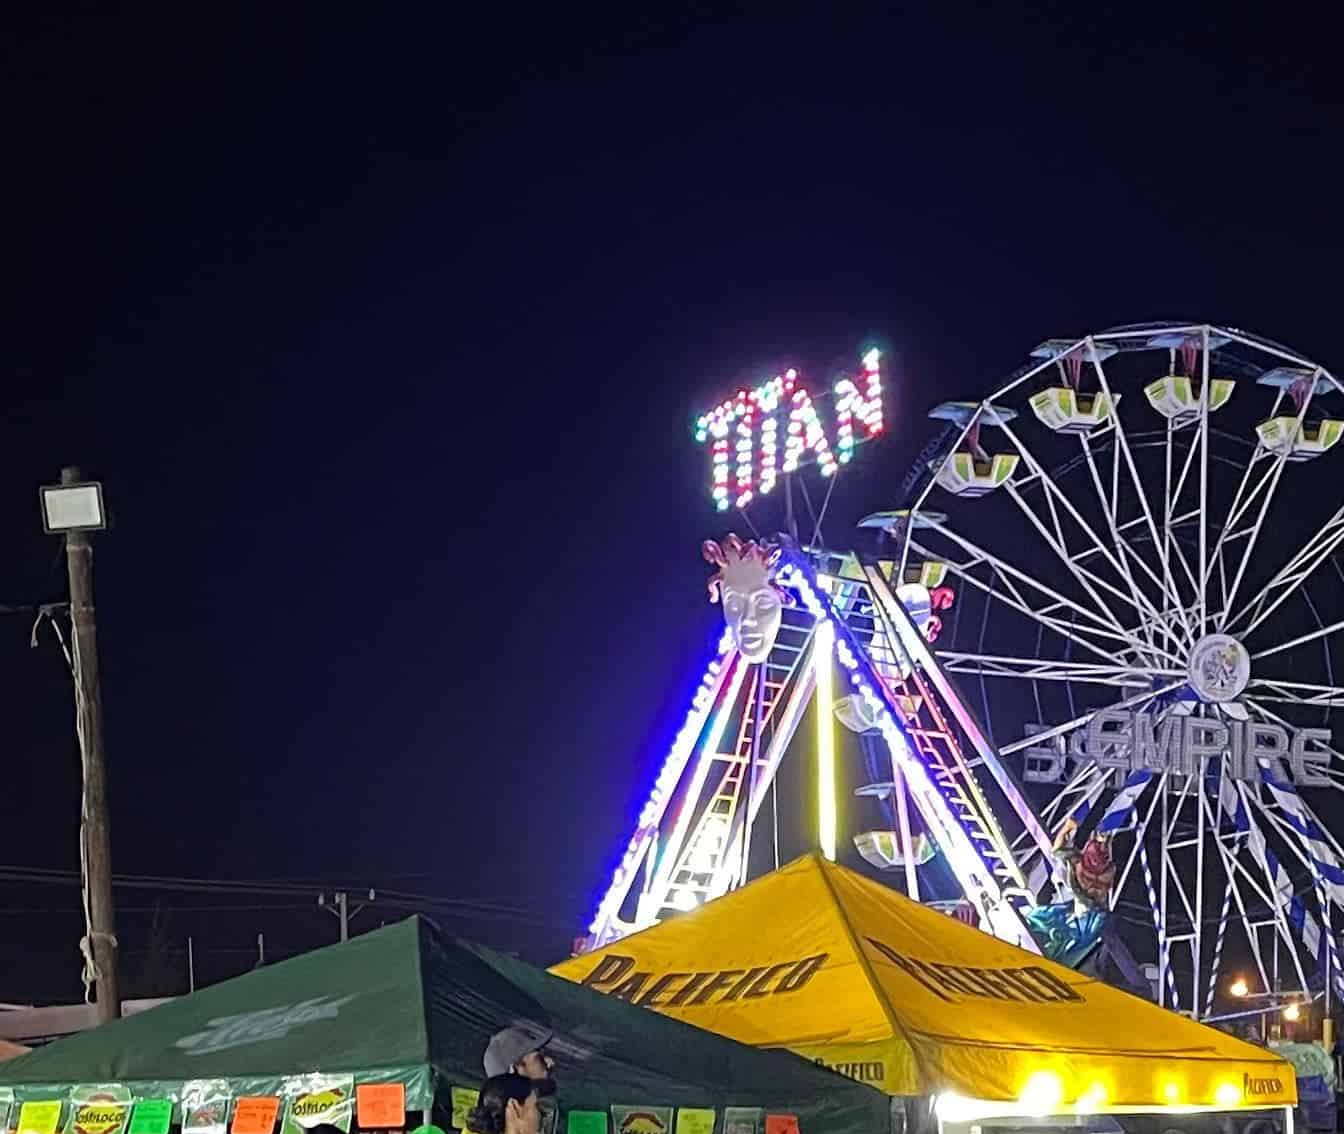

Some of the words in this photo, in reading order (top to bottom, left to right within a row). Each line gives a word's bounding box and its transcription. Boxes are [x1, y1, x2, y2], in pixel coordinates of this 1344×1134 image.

[696, 347, 884, 512] TITAN
[1089, 710, 1332, 787] EMPIRE
[581, 953, 828, 1006] PACIFICO
[815, 1057, 884, 1081] CIFICO
